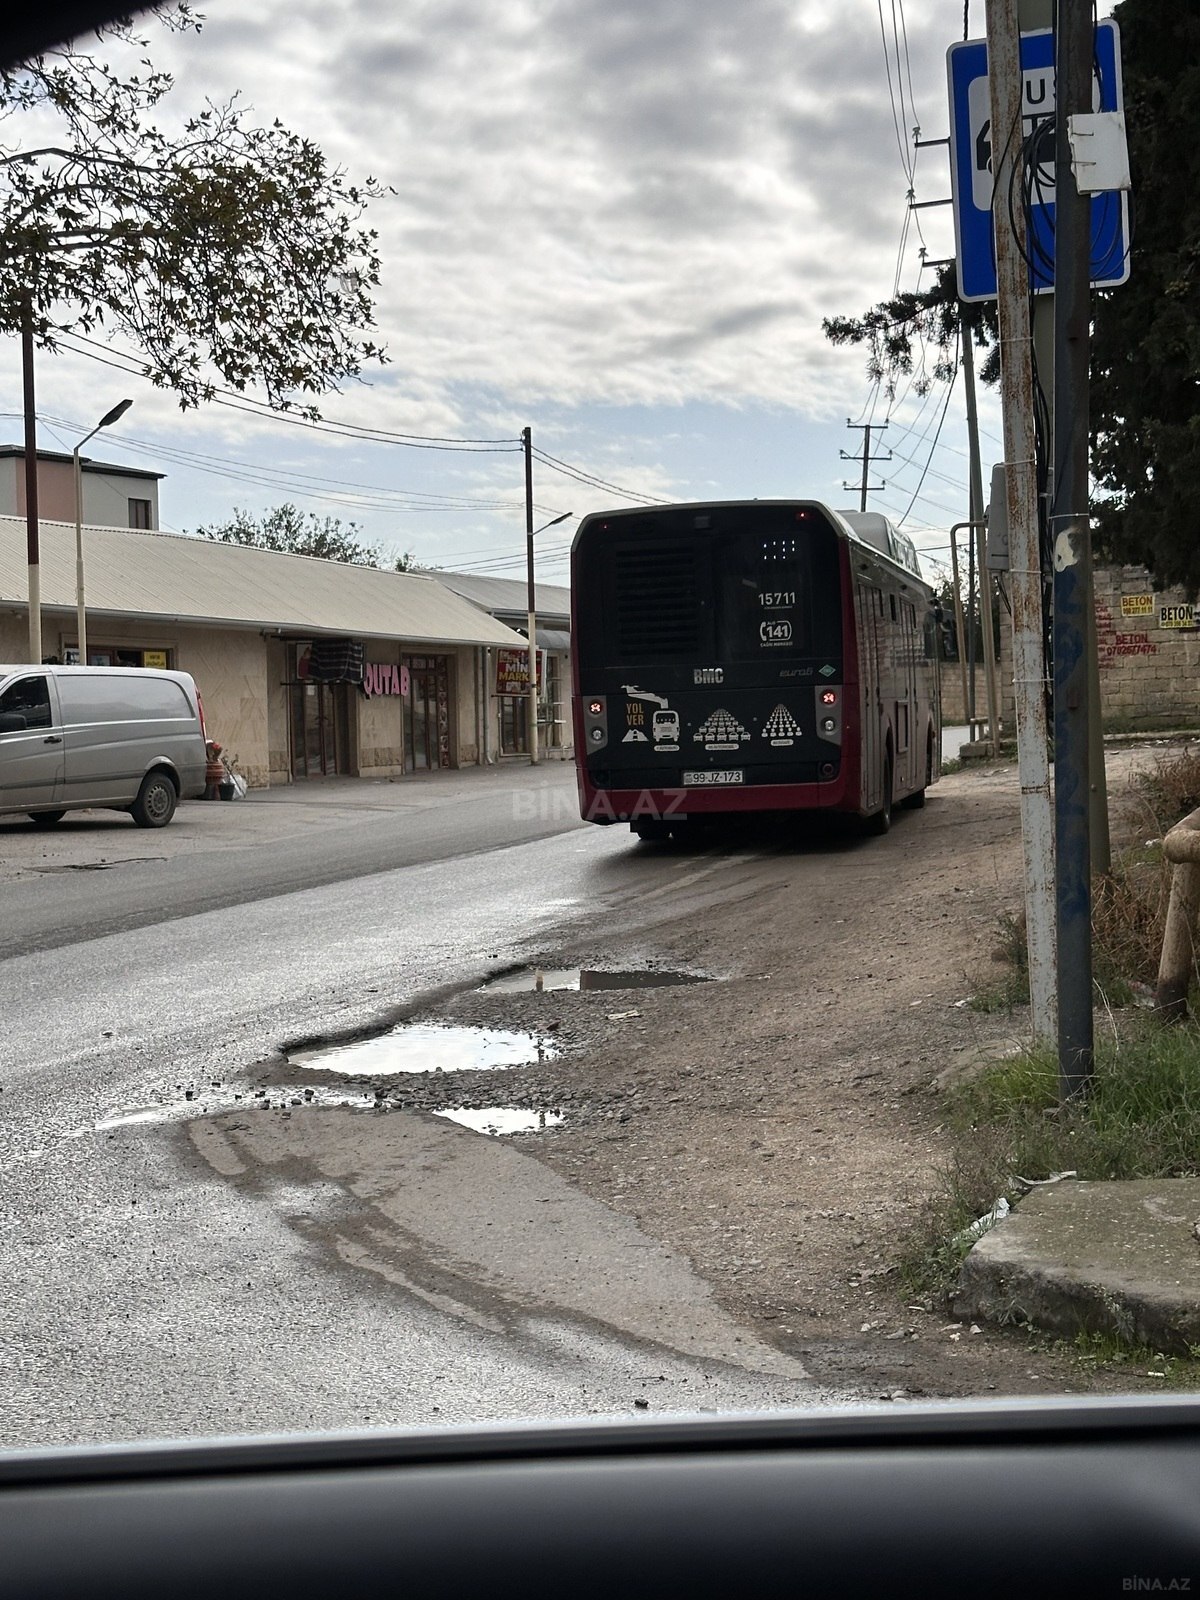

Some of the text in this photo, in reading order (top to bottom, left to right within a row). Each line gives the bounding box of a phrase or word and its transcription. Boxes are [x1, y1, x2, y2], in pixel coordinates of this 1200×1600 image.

[758, 591, 796, 606] 15711
[1122, 596, 1153, 607] BETON
[1161, 606, 1193, 621] BETON
[766, 625, 789, 638] 141
[1115, 633, 1148, 645] BETON
[363, 661, 410, 699] QUTAB
[498, 672, 541, 682] MARKT
[693, 667, 724, 685] BMC
[626, 703, 644, 714] YOL
[626, 714, 644, 726] VER
